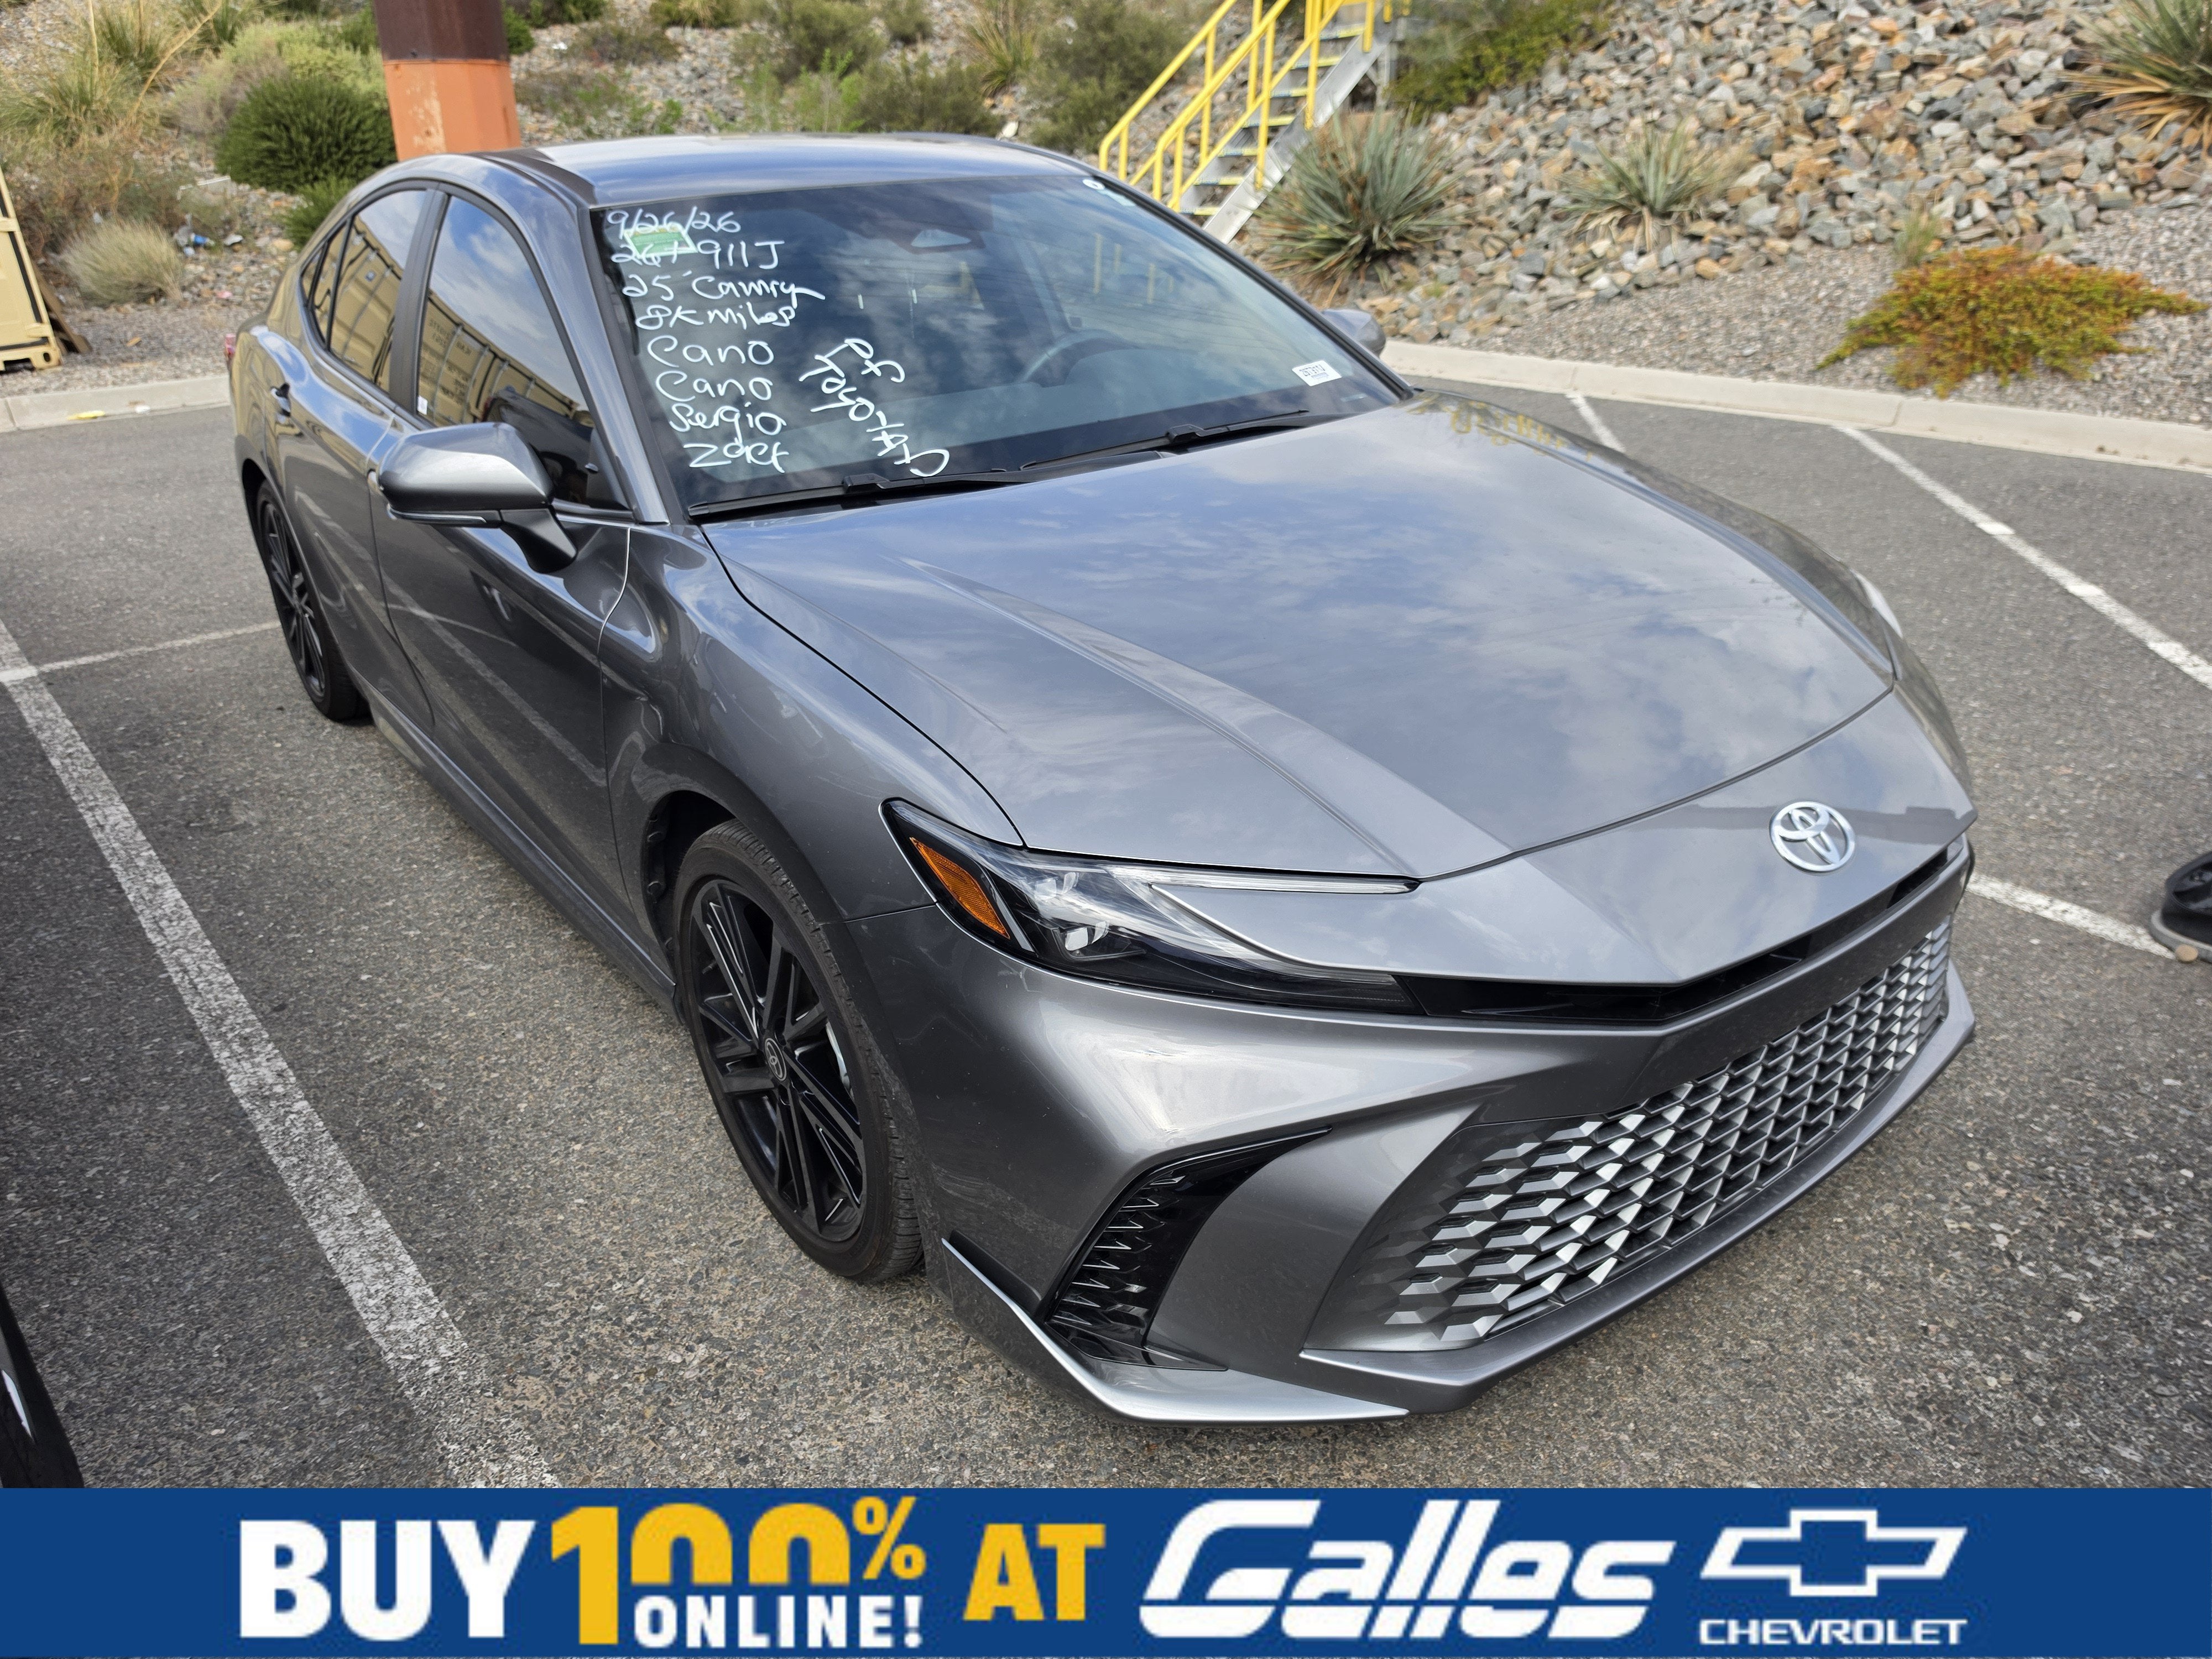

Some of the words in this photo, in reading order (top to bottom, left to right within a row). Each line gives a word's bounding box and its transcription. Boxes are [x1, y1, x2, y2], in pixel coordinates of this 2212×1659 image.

[692, 275, 826, 309] Camry
[647, 335, 774, 367] Cano
[655, 370, 773, 402] Cano
[669, 401, 787, 444] Sergio
